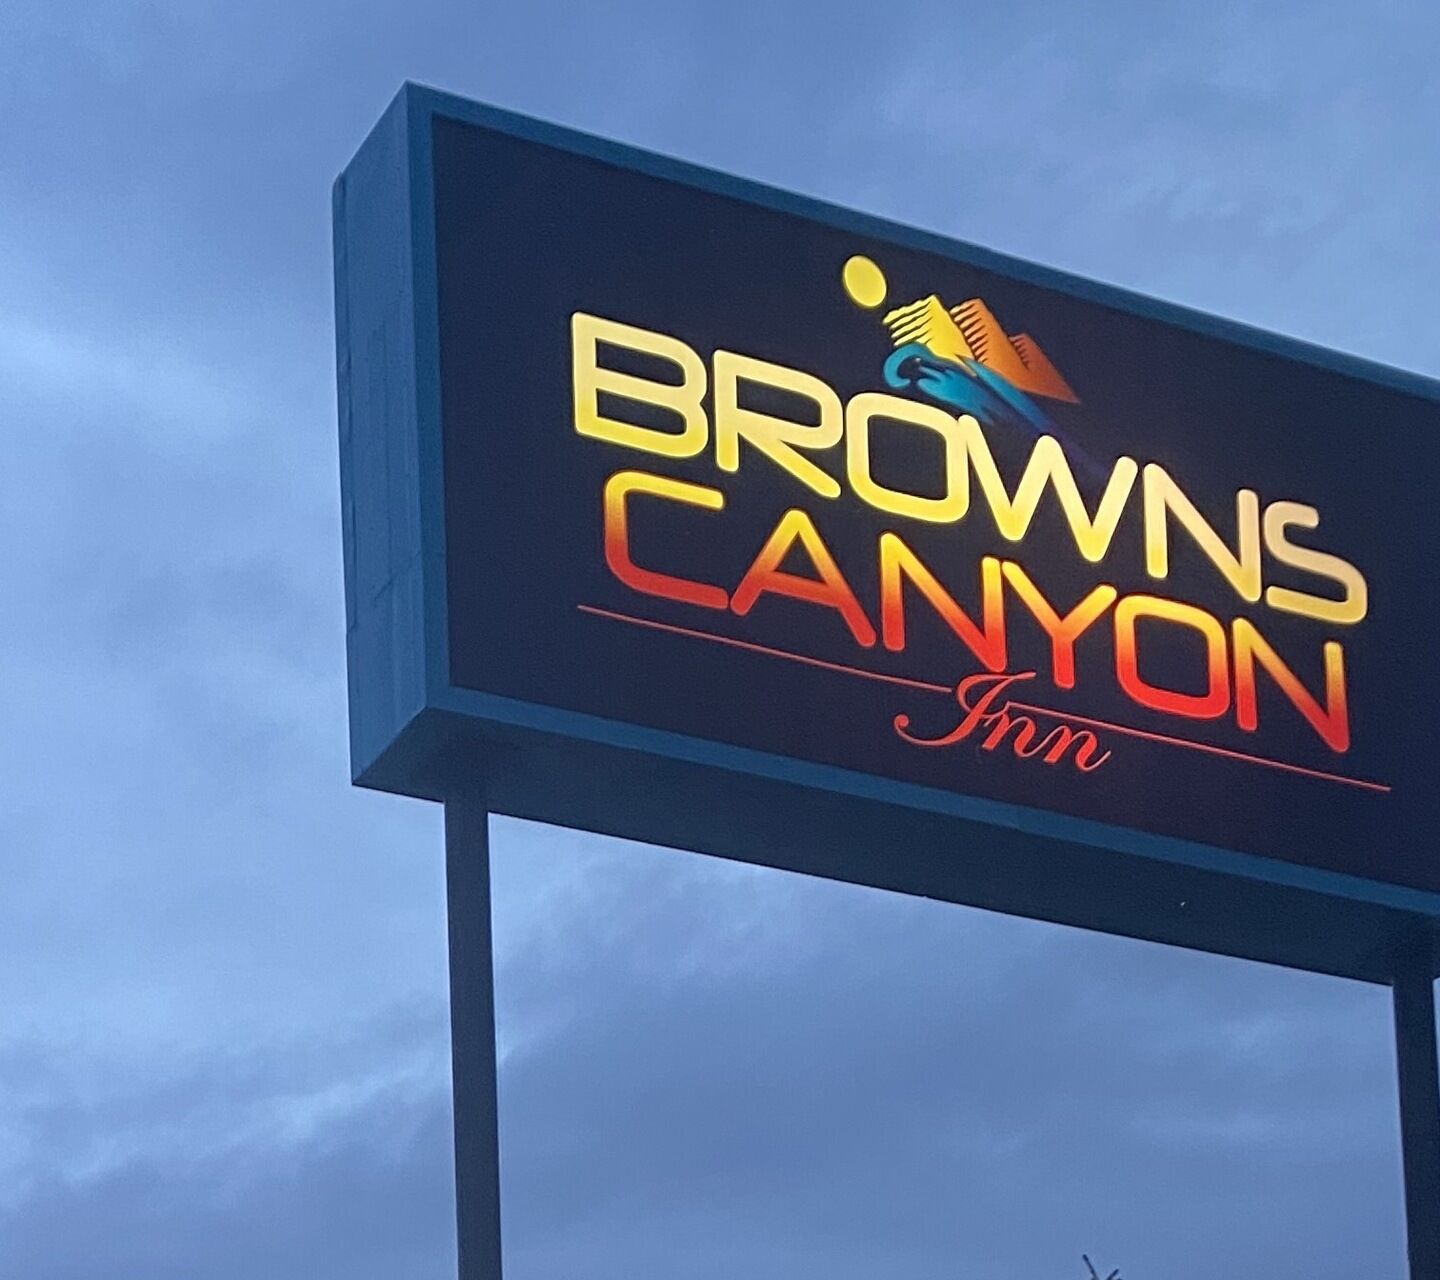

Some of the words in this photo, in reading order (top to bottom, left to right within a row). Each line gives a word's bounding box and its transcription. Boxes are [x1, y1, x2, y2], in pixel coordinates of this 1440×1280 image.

[571, 312, 1368, 623] BROWNS
[603, 470, 1352, 752] CANYON
[894, 671, 1112, 773] Inn
